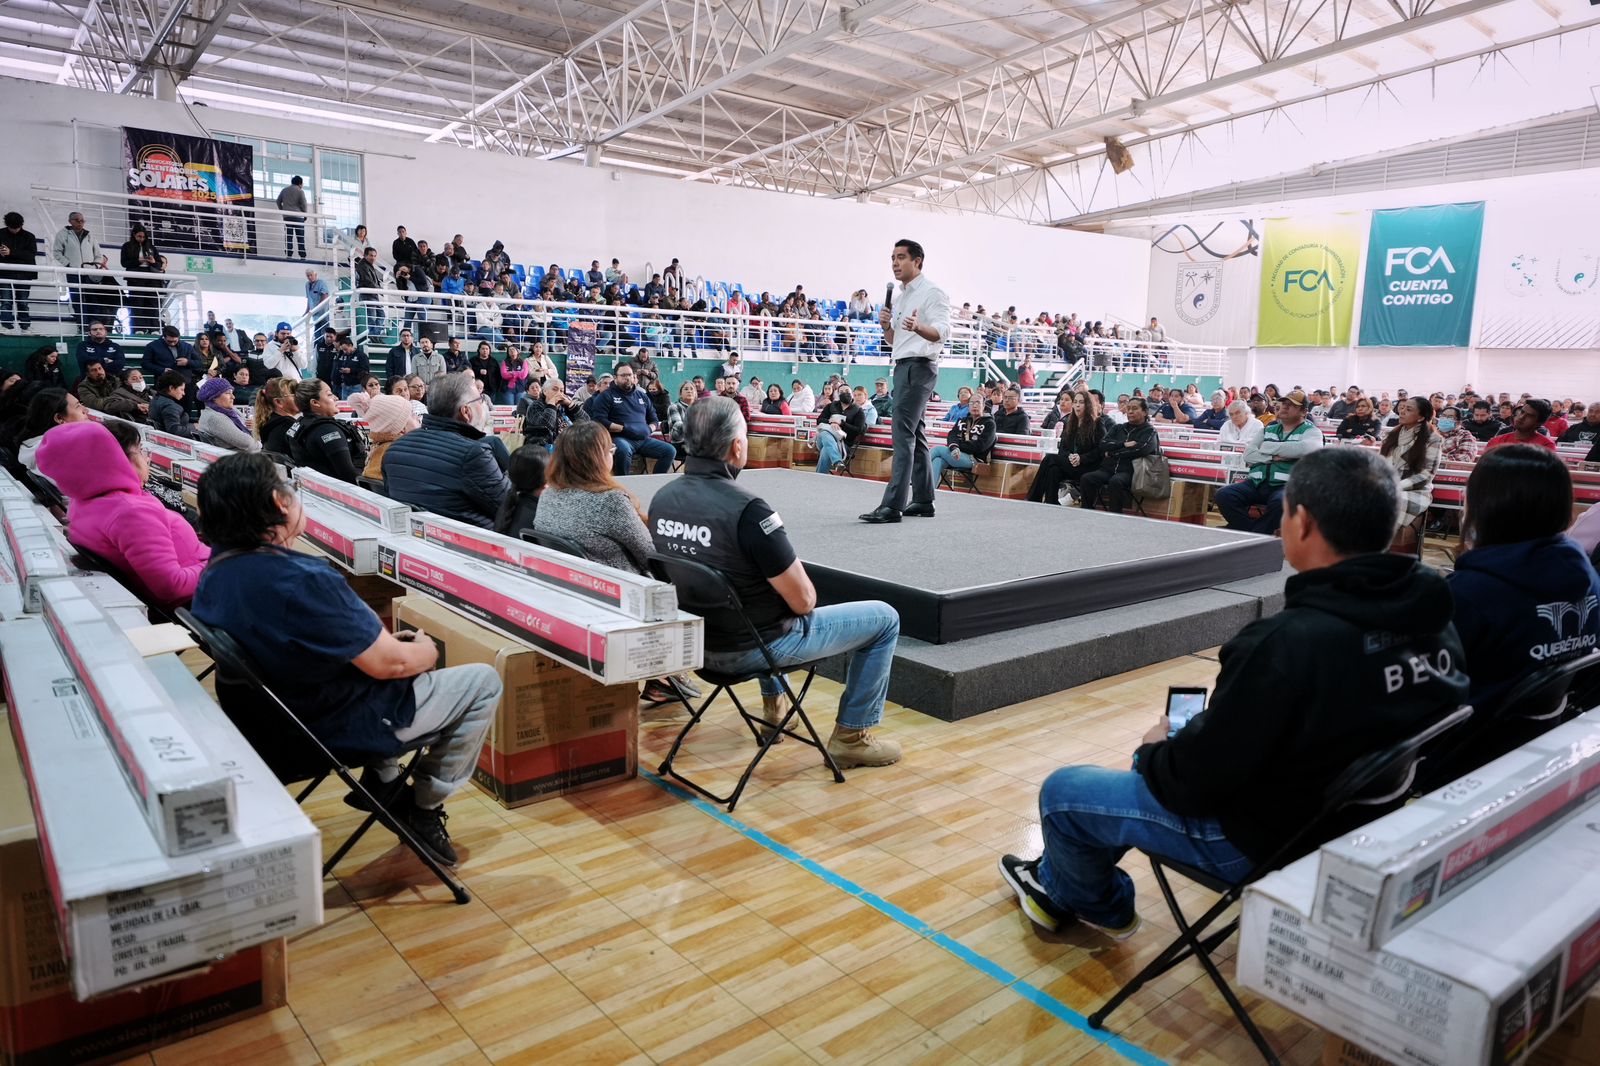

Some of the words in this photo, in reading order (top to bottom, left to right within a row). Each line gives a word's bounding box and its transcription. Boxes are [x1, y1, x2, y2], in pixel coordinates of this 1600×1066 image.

[140, 162, 199, 175] CALENTADORES
[128, 167, 209, 191] SOLARES
[191, 190, 217, 200] 2025
[1383, 245, 1457, 276] FCA
[1283, 269, 1335, 293] FCA
[1388, 279, 1449, 292] CUENTA
[1381, 293, 1454, 306] CONTIGO
[656, 518, 712, 547] SSPMQ
[1529, 634, 1596, 661] QUERÉTARO
[516, 727, 542, 741] TANQUE
